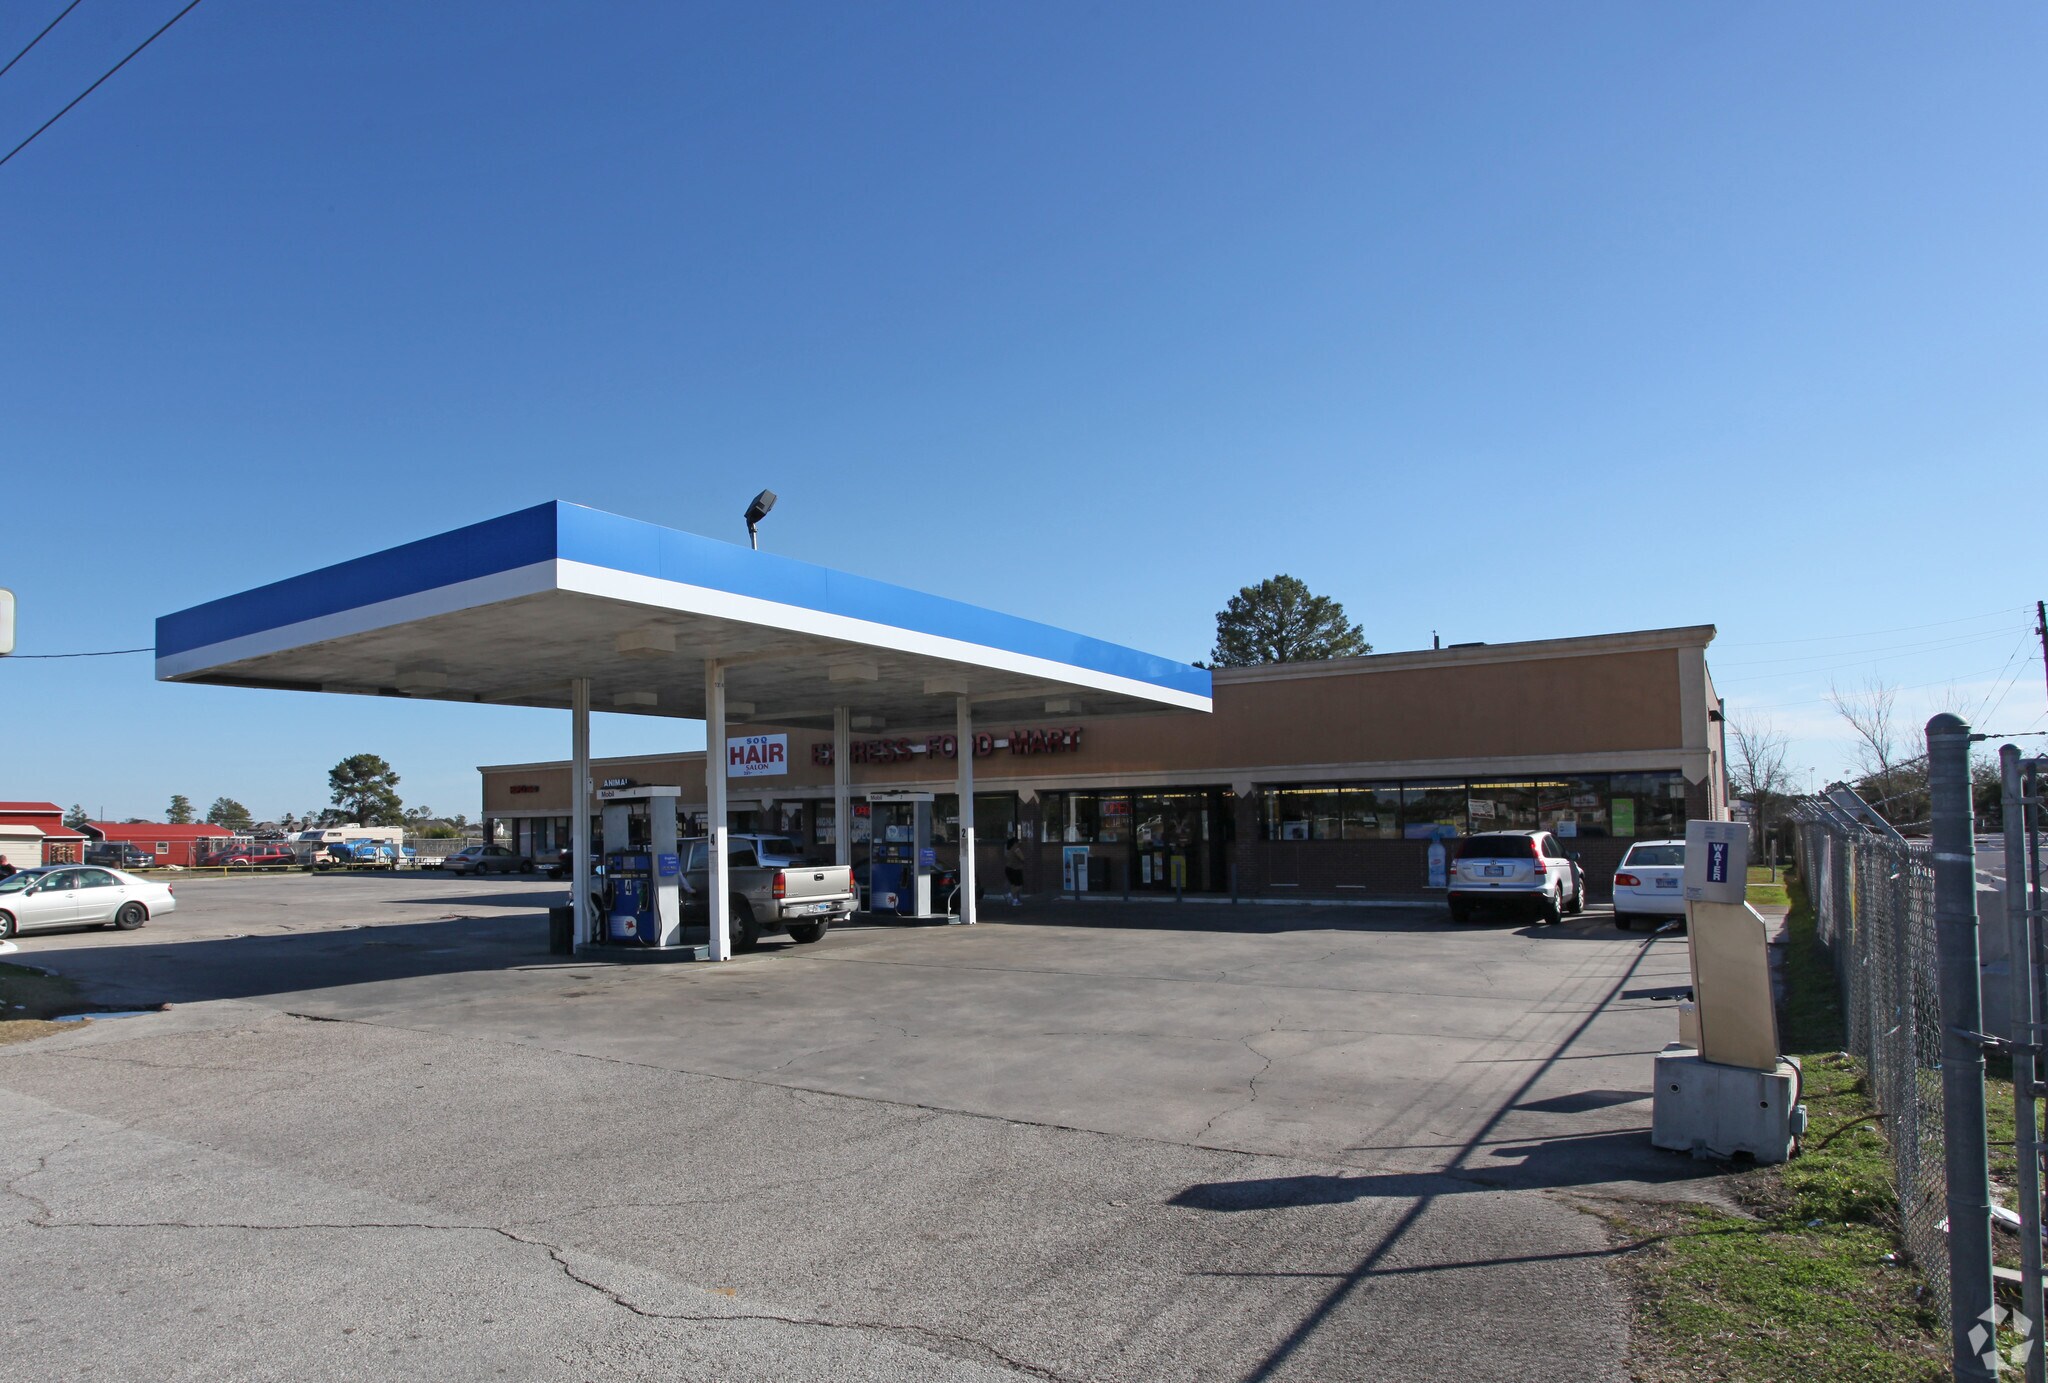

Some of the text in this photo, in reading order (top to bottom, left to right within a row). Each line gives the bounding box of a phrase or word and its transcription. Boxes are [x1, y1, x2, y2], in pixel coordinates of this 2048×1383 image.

[811, 726, 1083, 766] EXRESS FOD MART
[730, 743, 784, 765] HAIR
[745, 763, 769, 771] SALON
[710, 833, 715, 846] 4
[961, 828, 966, 838] 2
[1712, 843, 1724, 881] WATER
[625, 880, 631, 894] 4
